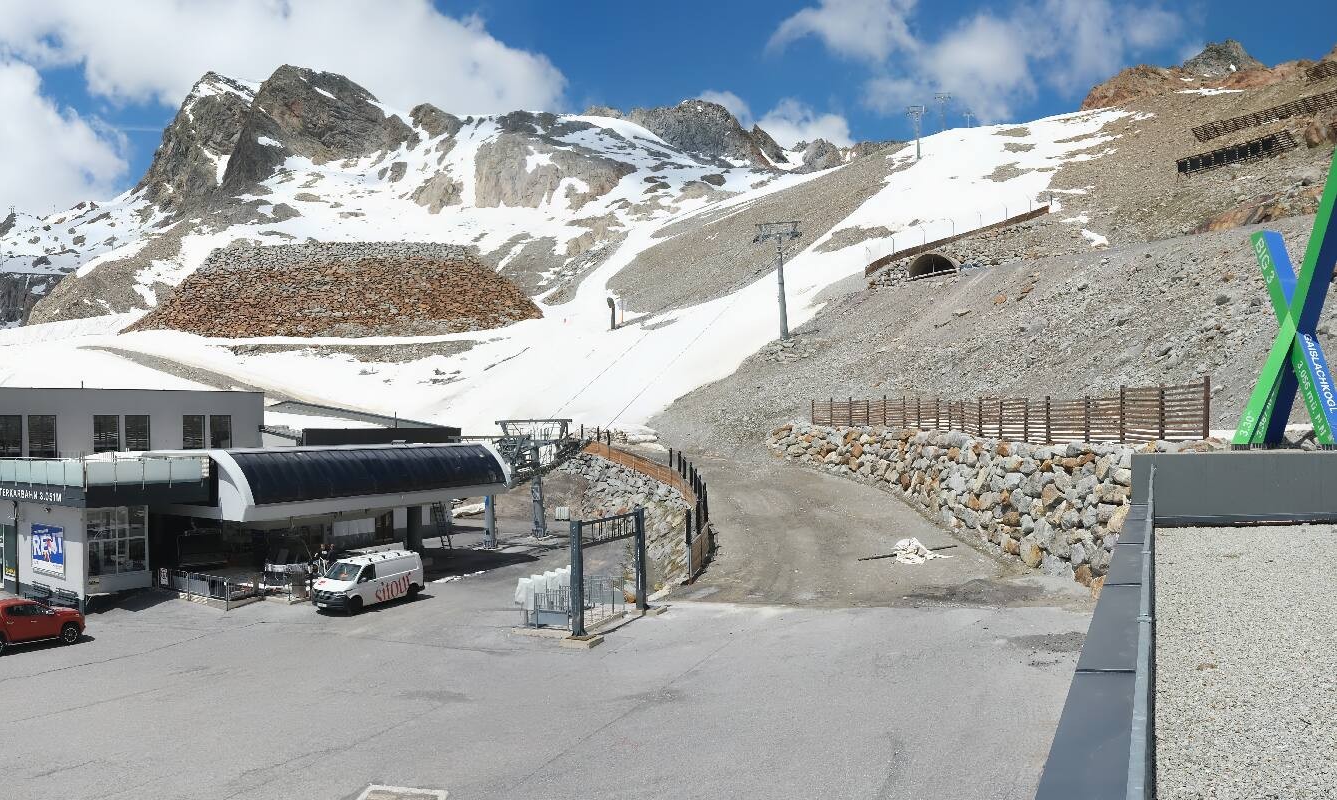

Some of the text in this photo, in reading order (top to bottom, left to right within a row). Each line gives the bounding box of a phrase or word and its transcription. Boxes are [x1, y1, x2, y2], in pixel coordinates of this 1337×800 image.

[1255, 237, 1275, 284] BIG 3
[375, 572, 411, 602] sitour
